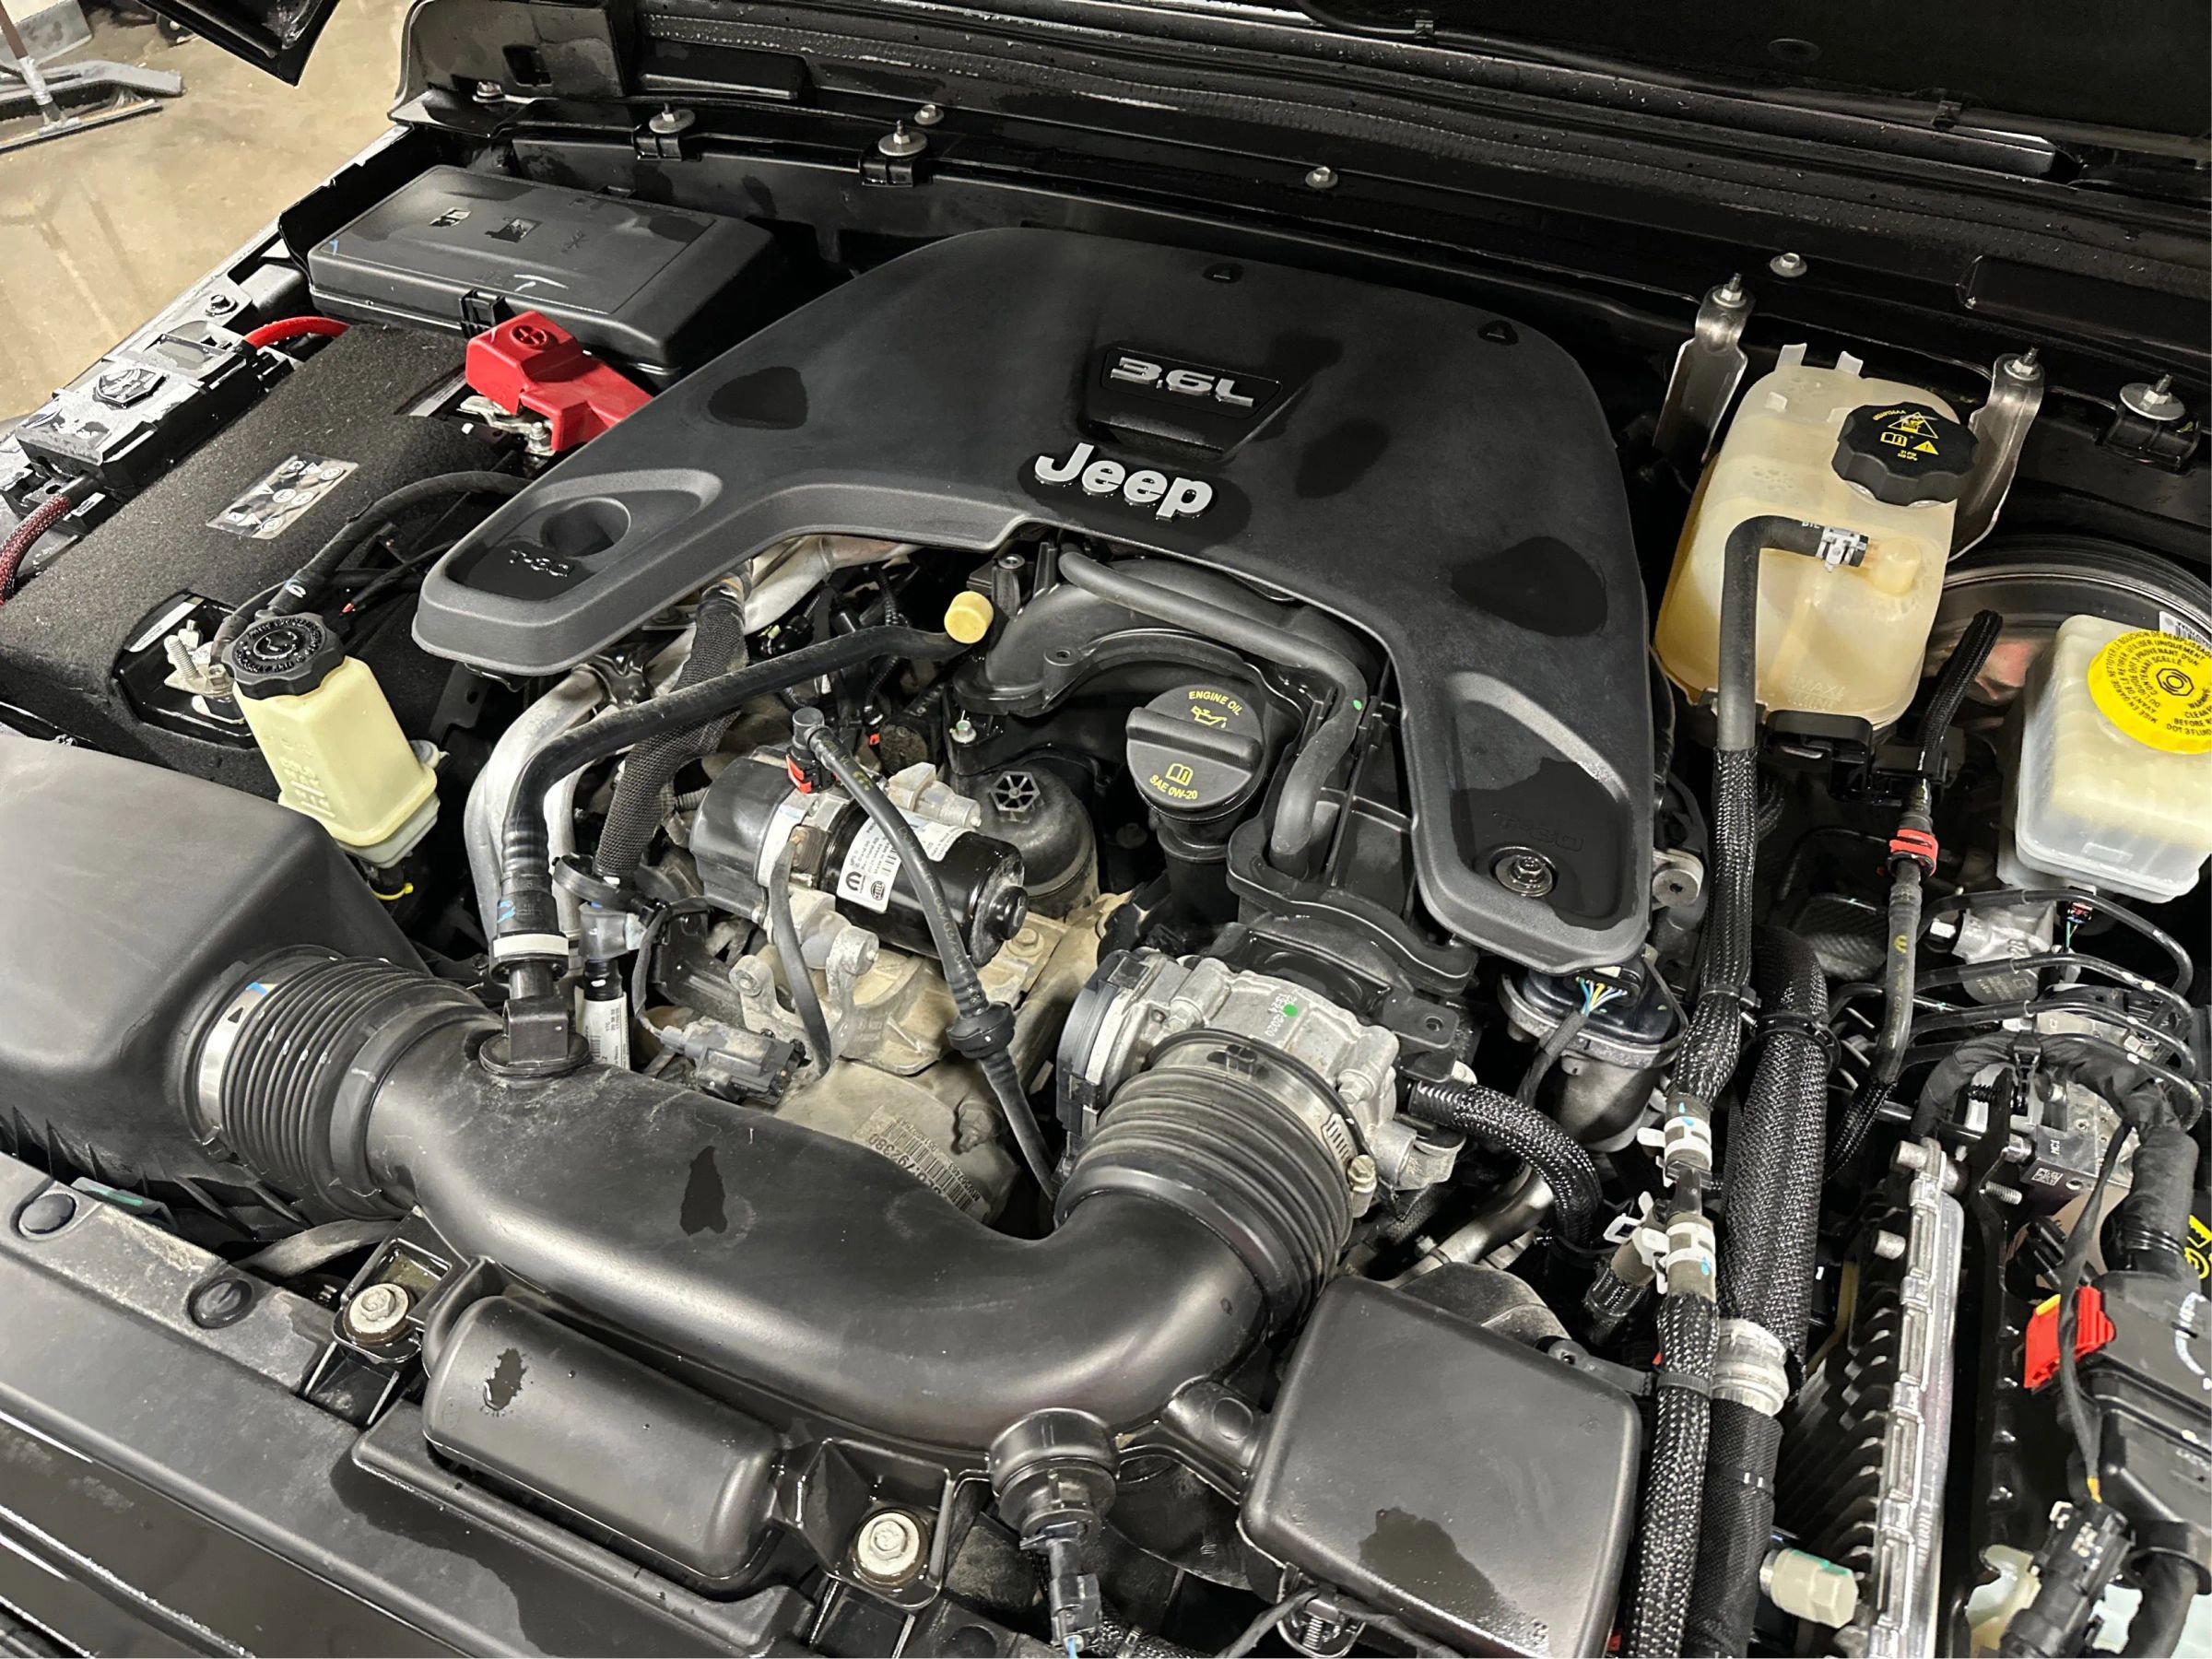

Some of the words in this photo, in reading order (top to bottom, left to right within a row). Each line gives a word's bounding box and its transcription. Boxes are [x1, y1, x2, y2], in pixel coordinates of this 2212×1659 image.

[1110, 356, 1254, 407] 3.6L
[1033, 442, 1214, 523] Jeep
[1188, 690, 1230, 705] ENGINE
[1227, 700, 1243, 716] OIL
[1149, 774, 1170, 793] SAE
[1168, 787, 1198, 800] 0W-20
